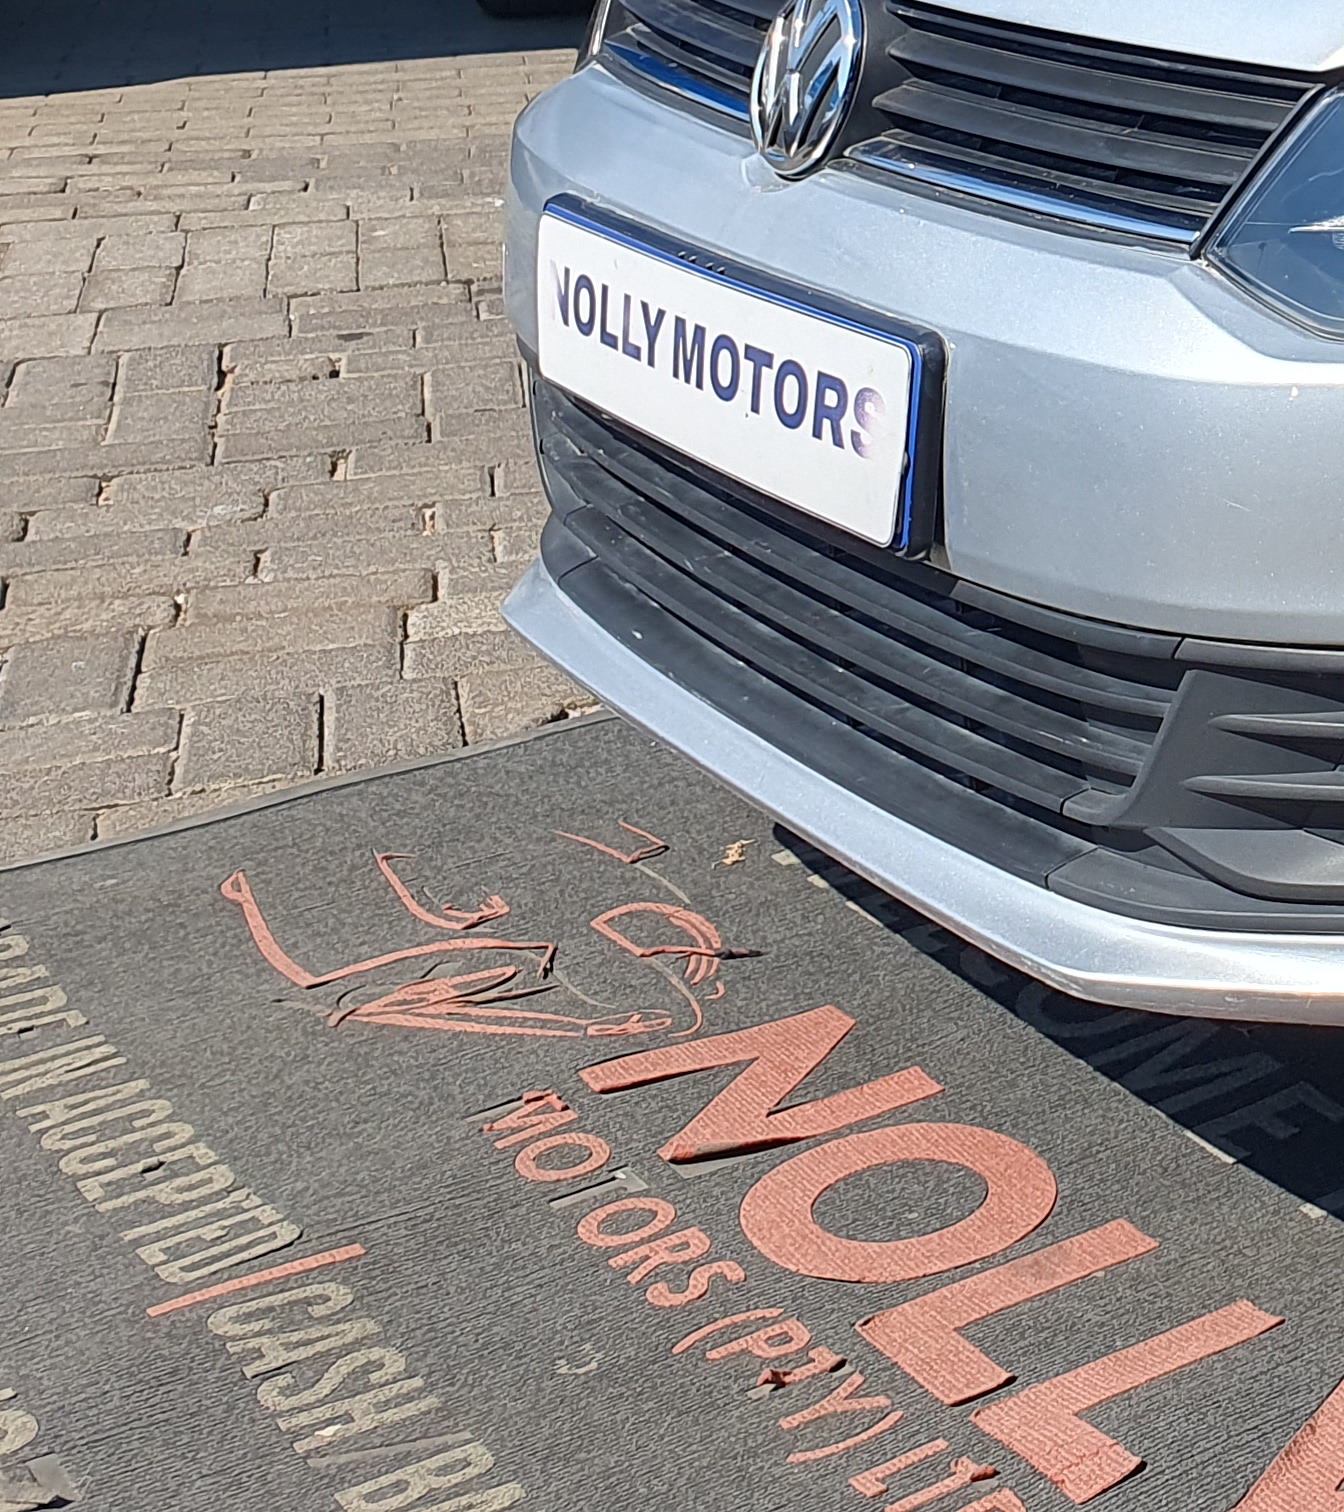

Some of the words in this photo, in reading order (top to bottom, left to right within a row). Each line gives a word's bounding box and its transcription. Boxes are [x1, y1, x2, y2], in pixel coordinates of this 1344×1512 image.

[551, 260, 666, 368] NOLLY
[672, 316, 885, 459] MOTORS
[465, 1090, 745, 1307] MOTORS
